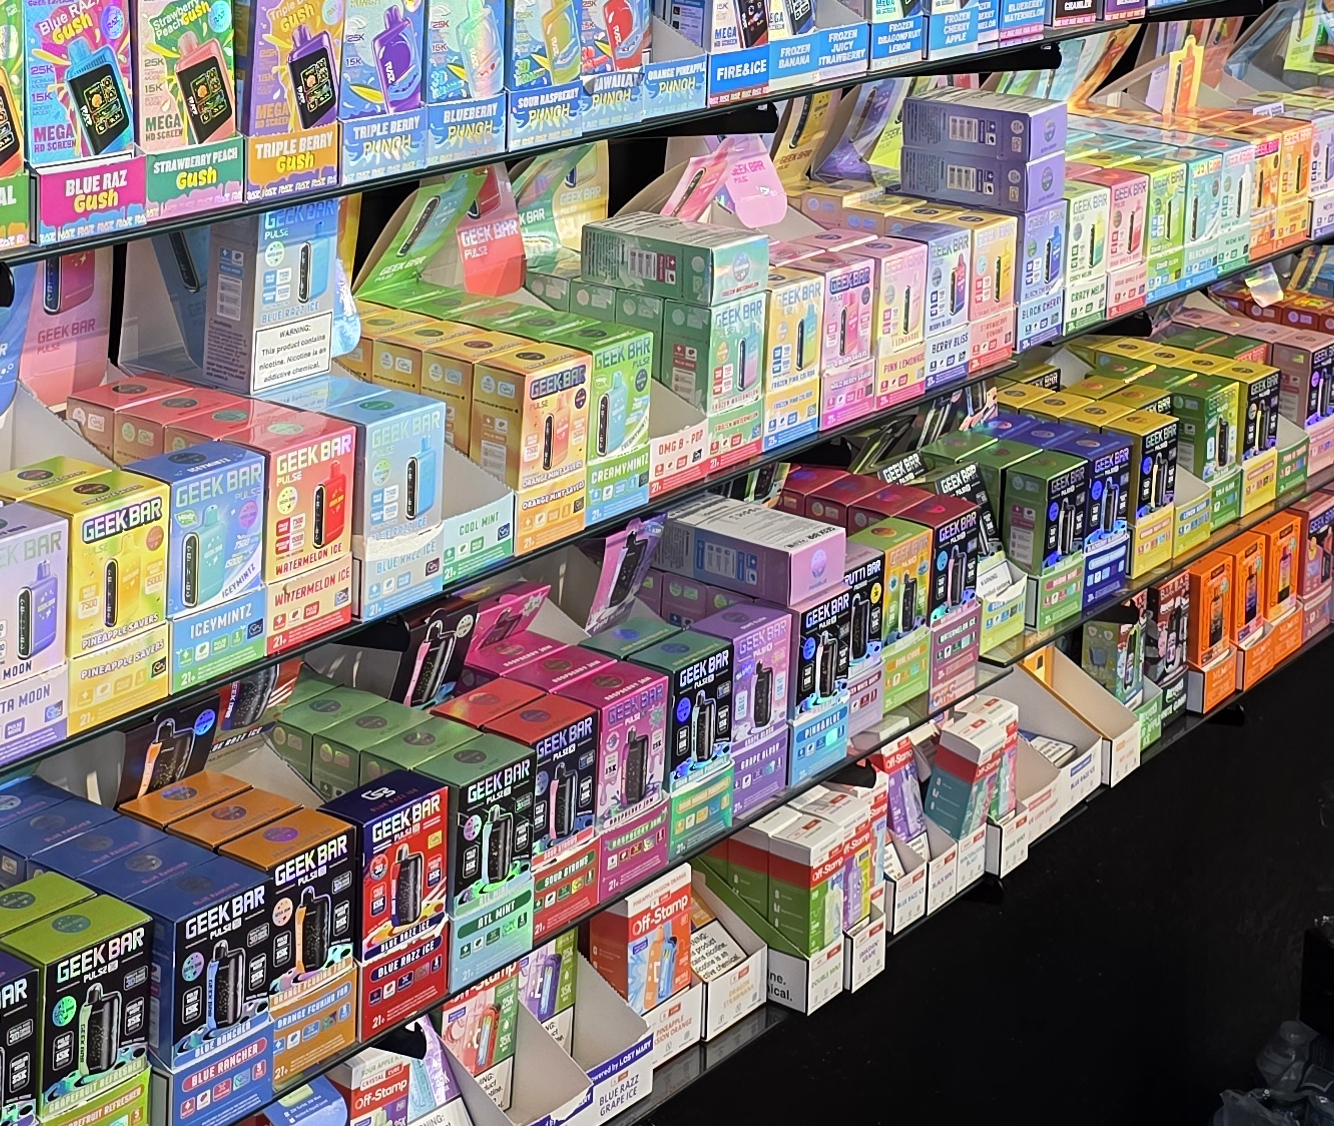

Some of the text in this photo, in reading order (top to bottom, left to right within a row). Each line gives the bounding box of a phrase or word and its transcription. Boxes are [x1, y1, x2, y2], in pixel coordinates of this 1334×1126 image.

[778, 53, 812, 69] BANANA
[780, 43, 811, 58] FROZEN
[716, 58, 767, 81] FIRE&ICE
[66, 170, 128, 197] BLUE RAZ
[74, 186, 119, 212] Gush
[458, 510, 500, 538] COOL MINT
[190, 602, 253, 637] ICEYMINTZ
[17, 684, 51, 714] MOON
[185, 885, 265, 939] GEEK BAR
[632, 893, 689, 936] Off-Stamp
[57, 927, 144, 981] GEEK BAR
